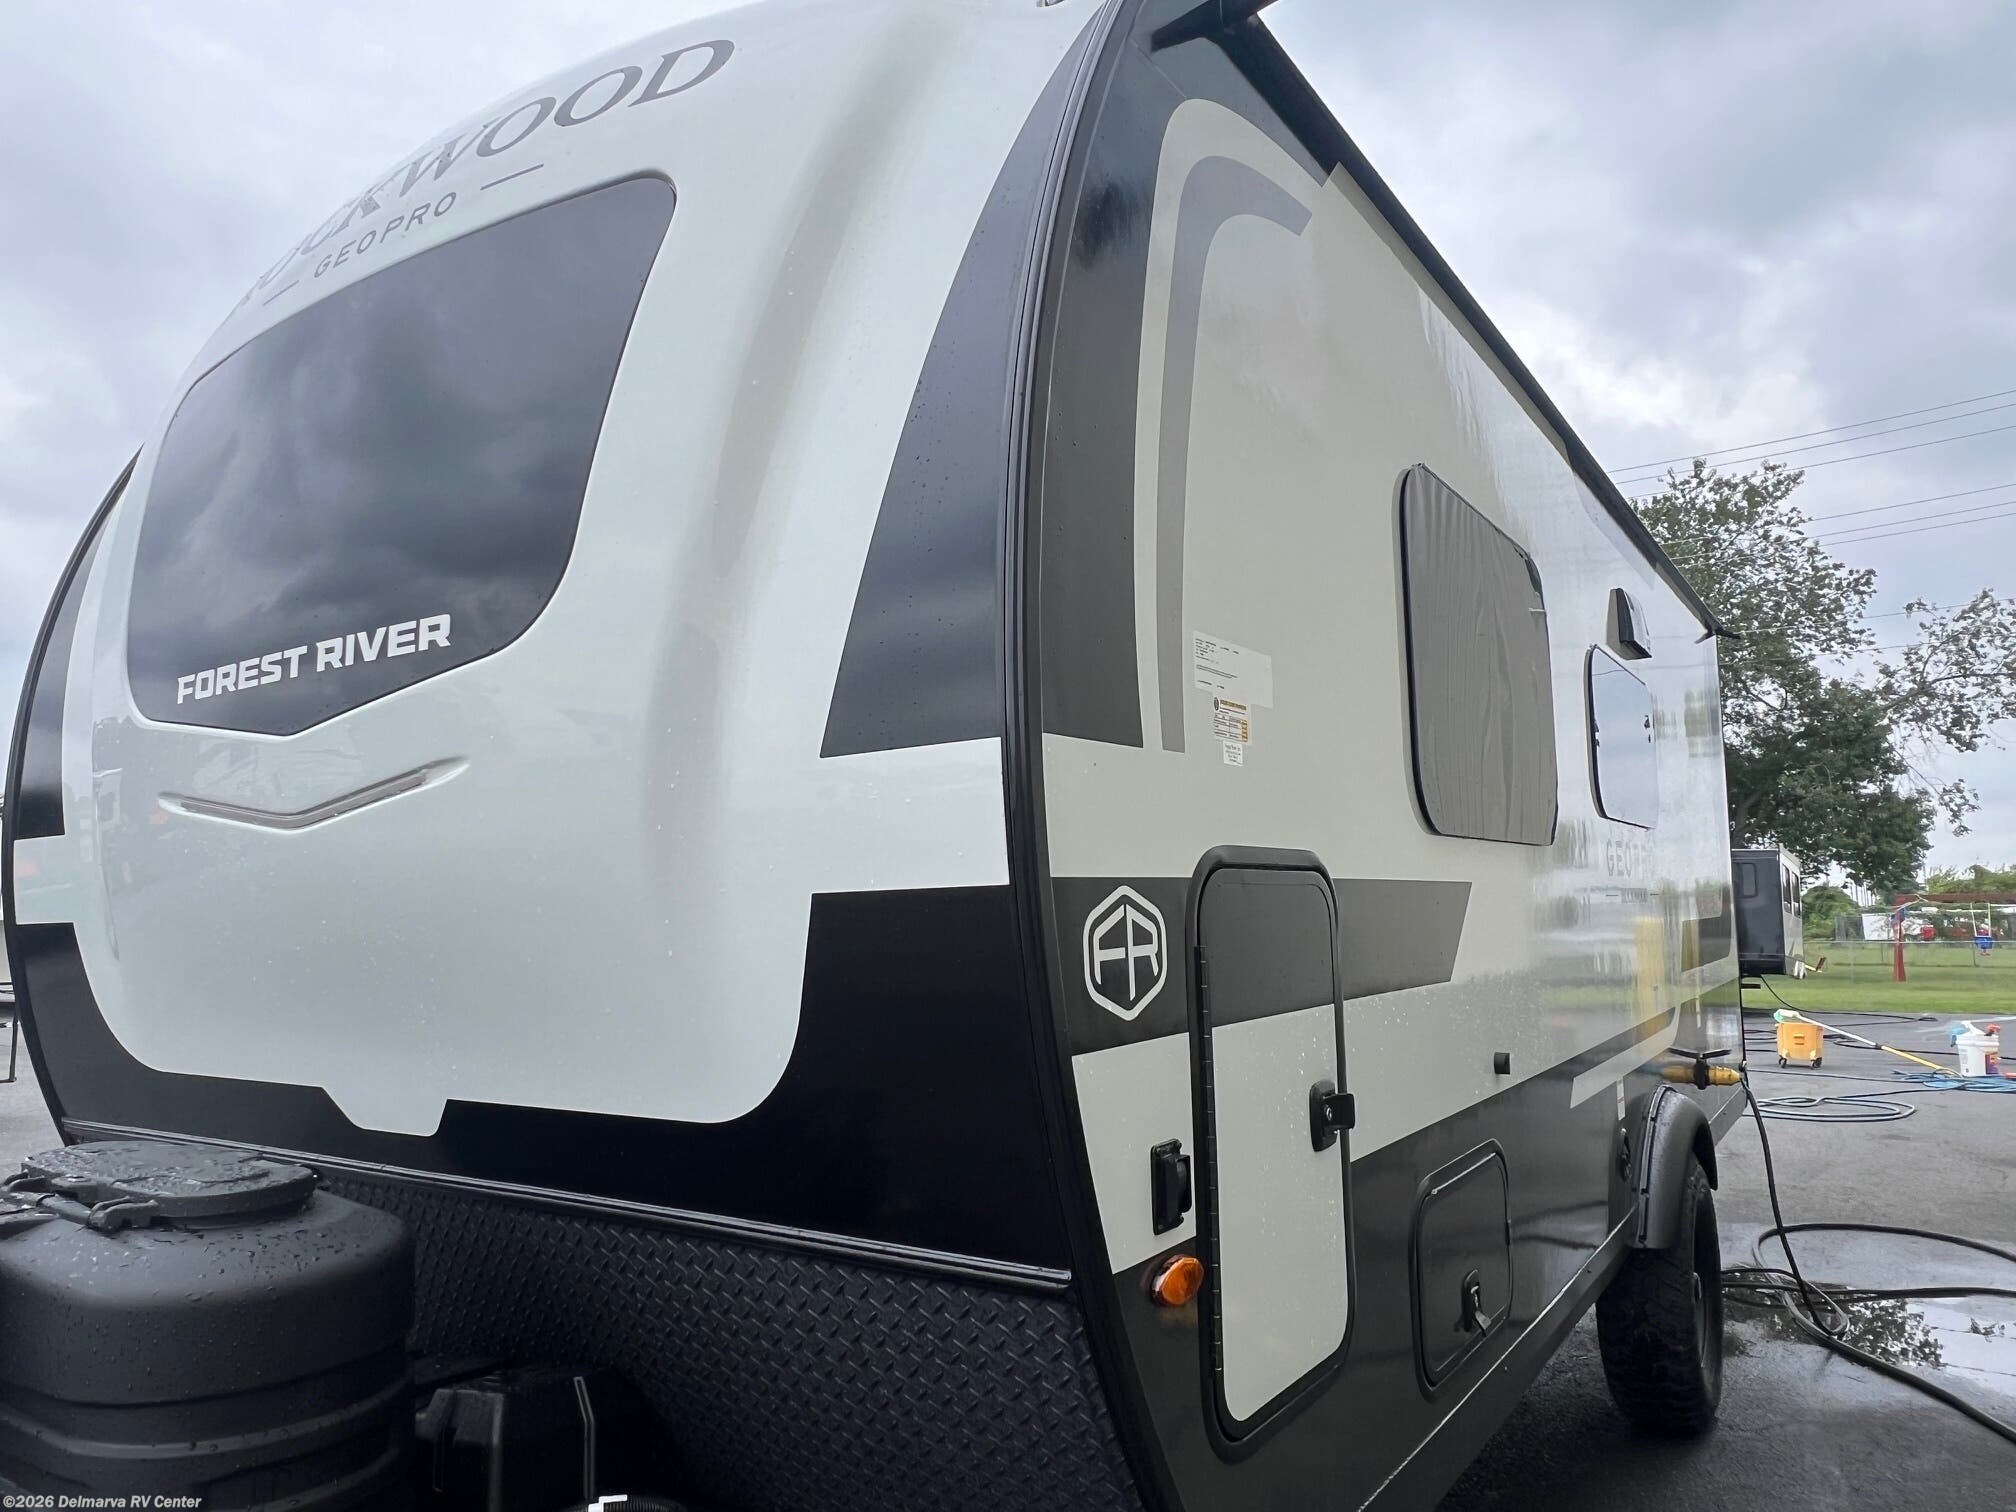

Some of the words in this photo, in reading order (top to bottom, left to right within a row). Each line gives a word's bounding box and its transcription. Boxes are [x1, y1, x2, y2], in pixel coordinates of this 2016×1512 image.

[313, 191, 457, 279] GEOPRO
[177, 645, 308, 704] FOREST
[315, 613, 451, 673] RIVER
